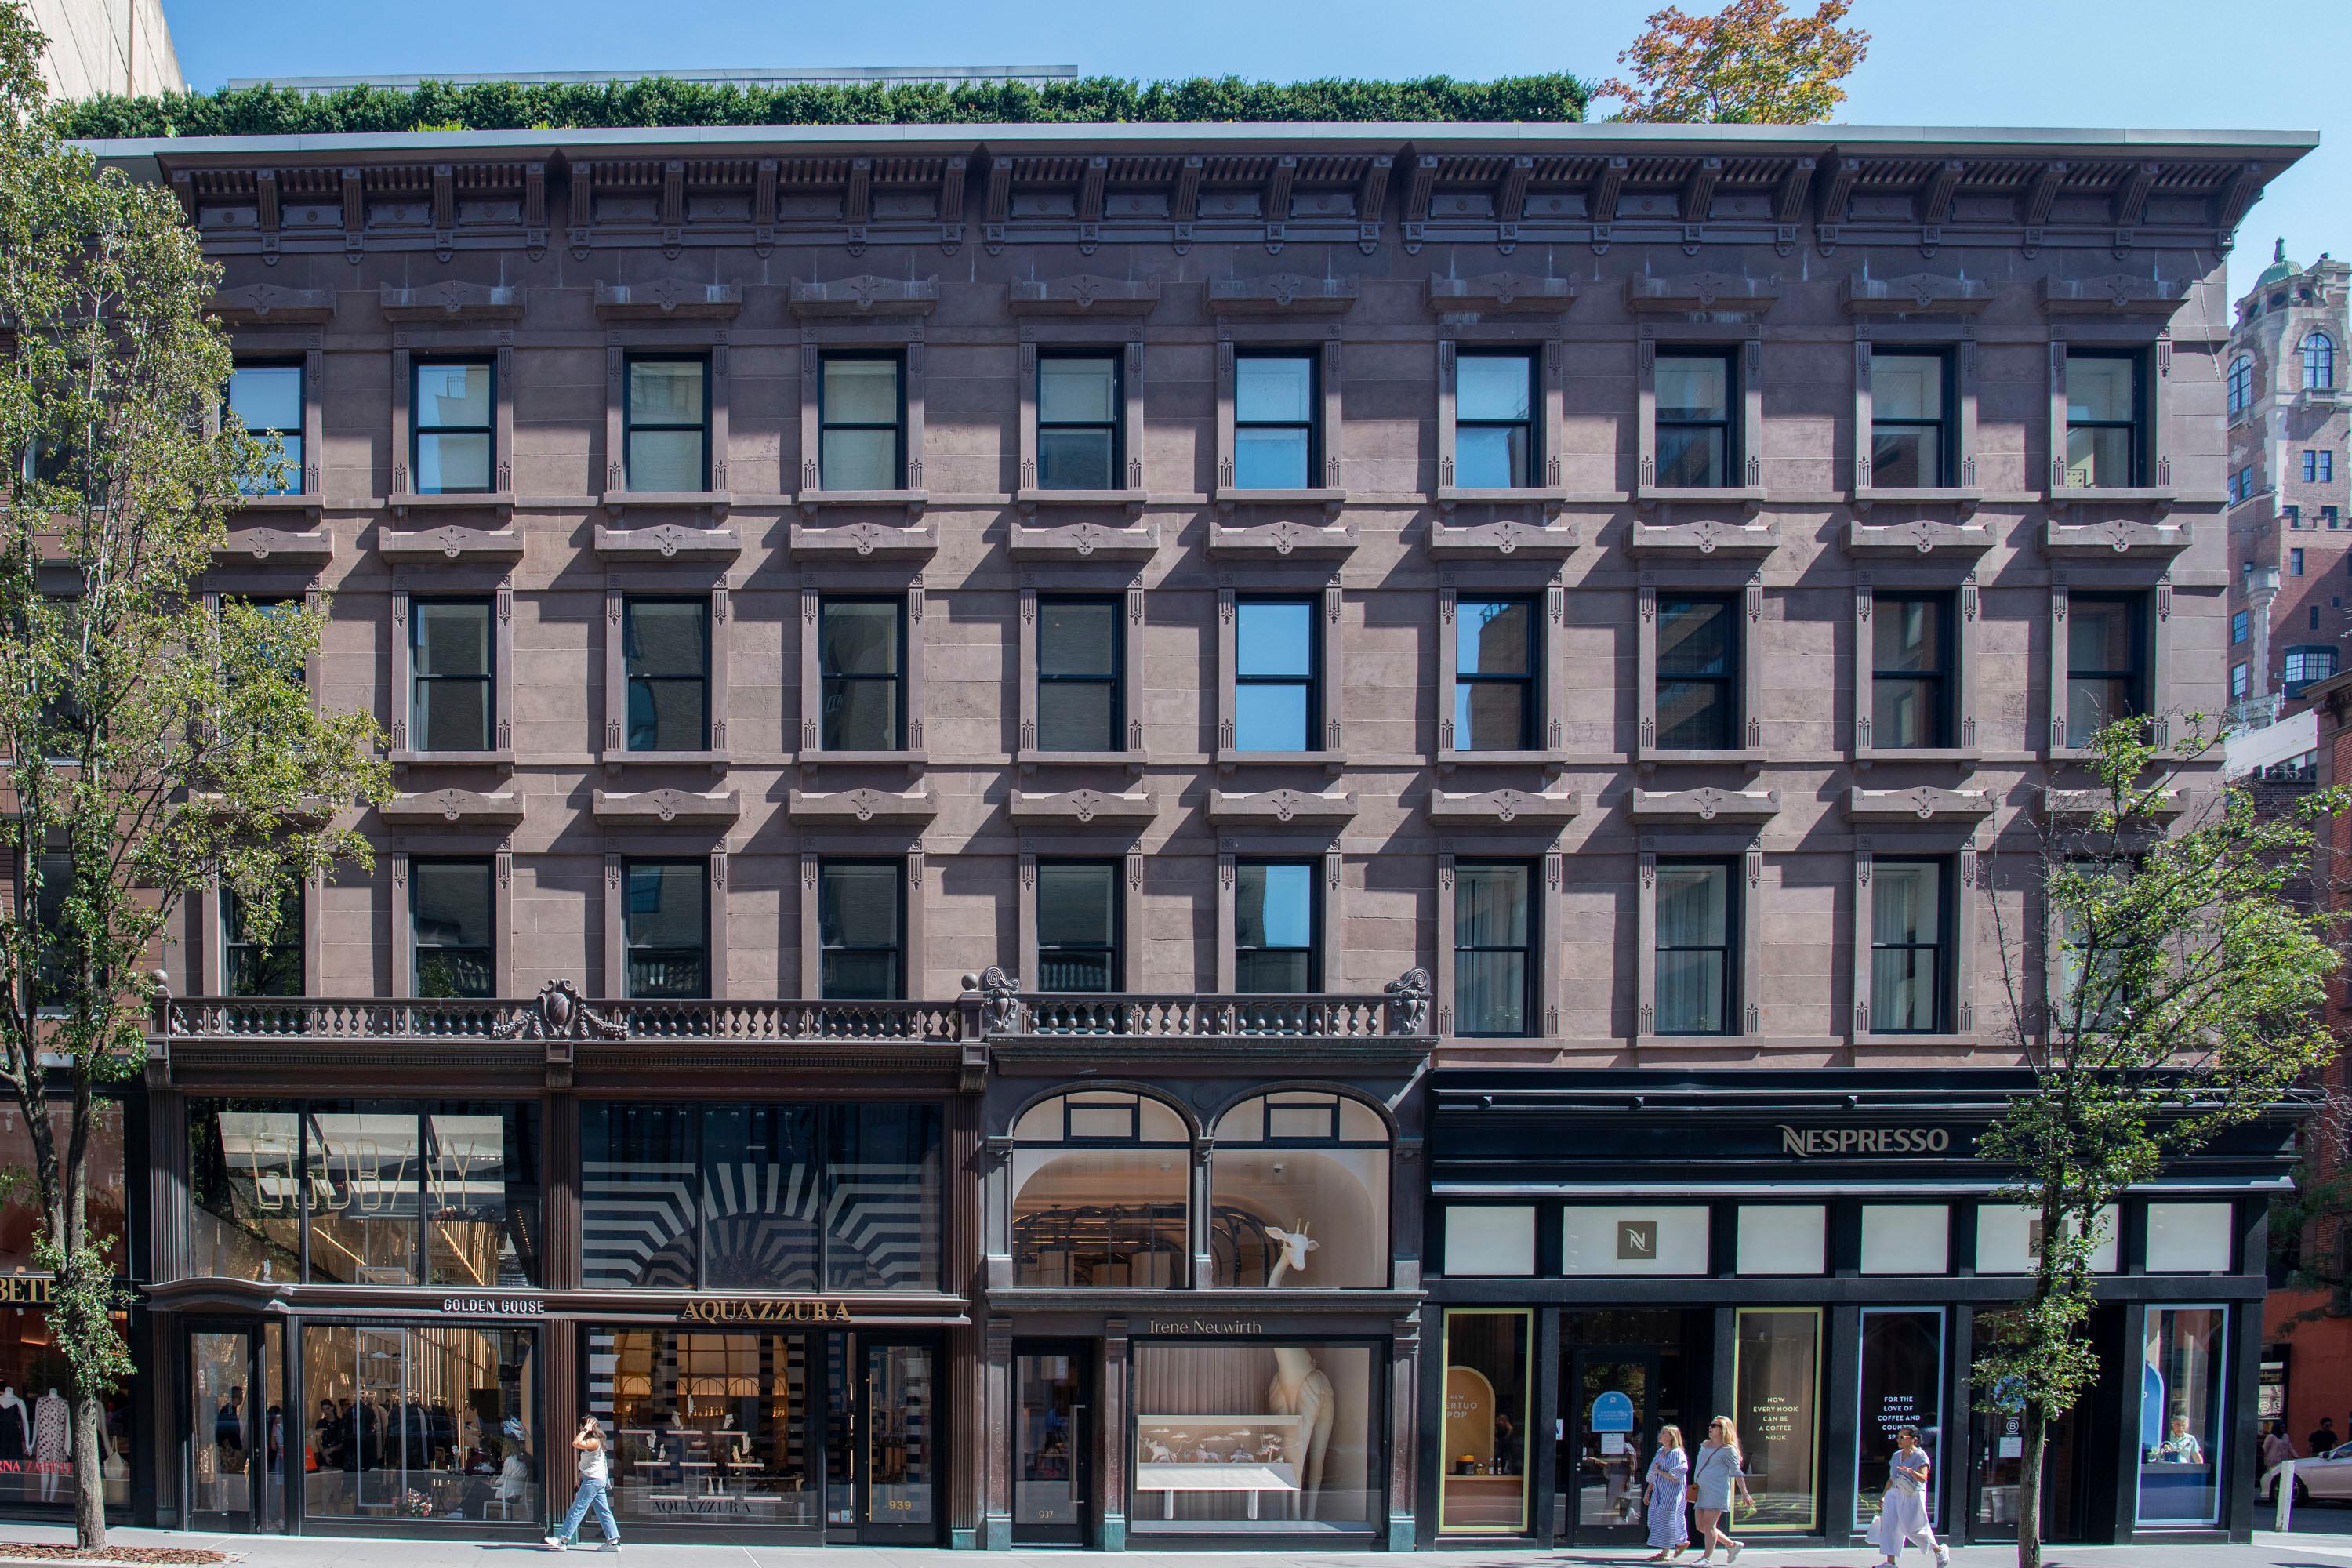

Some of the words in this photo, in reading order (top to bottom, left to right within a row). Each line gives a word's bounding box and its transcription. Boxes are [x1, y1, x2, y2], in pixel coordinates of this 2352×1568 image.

[1775, 1124, 1949, 1157] NESPRESSO
[444, 1298, 495, 1312] GOLDEN
[502, 1300, 545, 1312] GOOSE
[681, 1300, 851, 1325] AQUAZZURA
[1150, 1320, 1189, 1334] Irene
[1193, 1320, 1262, 1334] Neuwirth
[652, 1500, 752, 1513] AQUAZZURA
[889, 1501, 911, 1510] 939
[1038, 1510, 1054, 1519] 937
